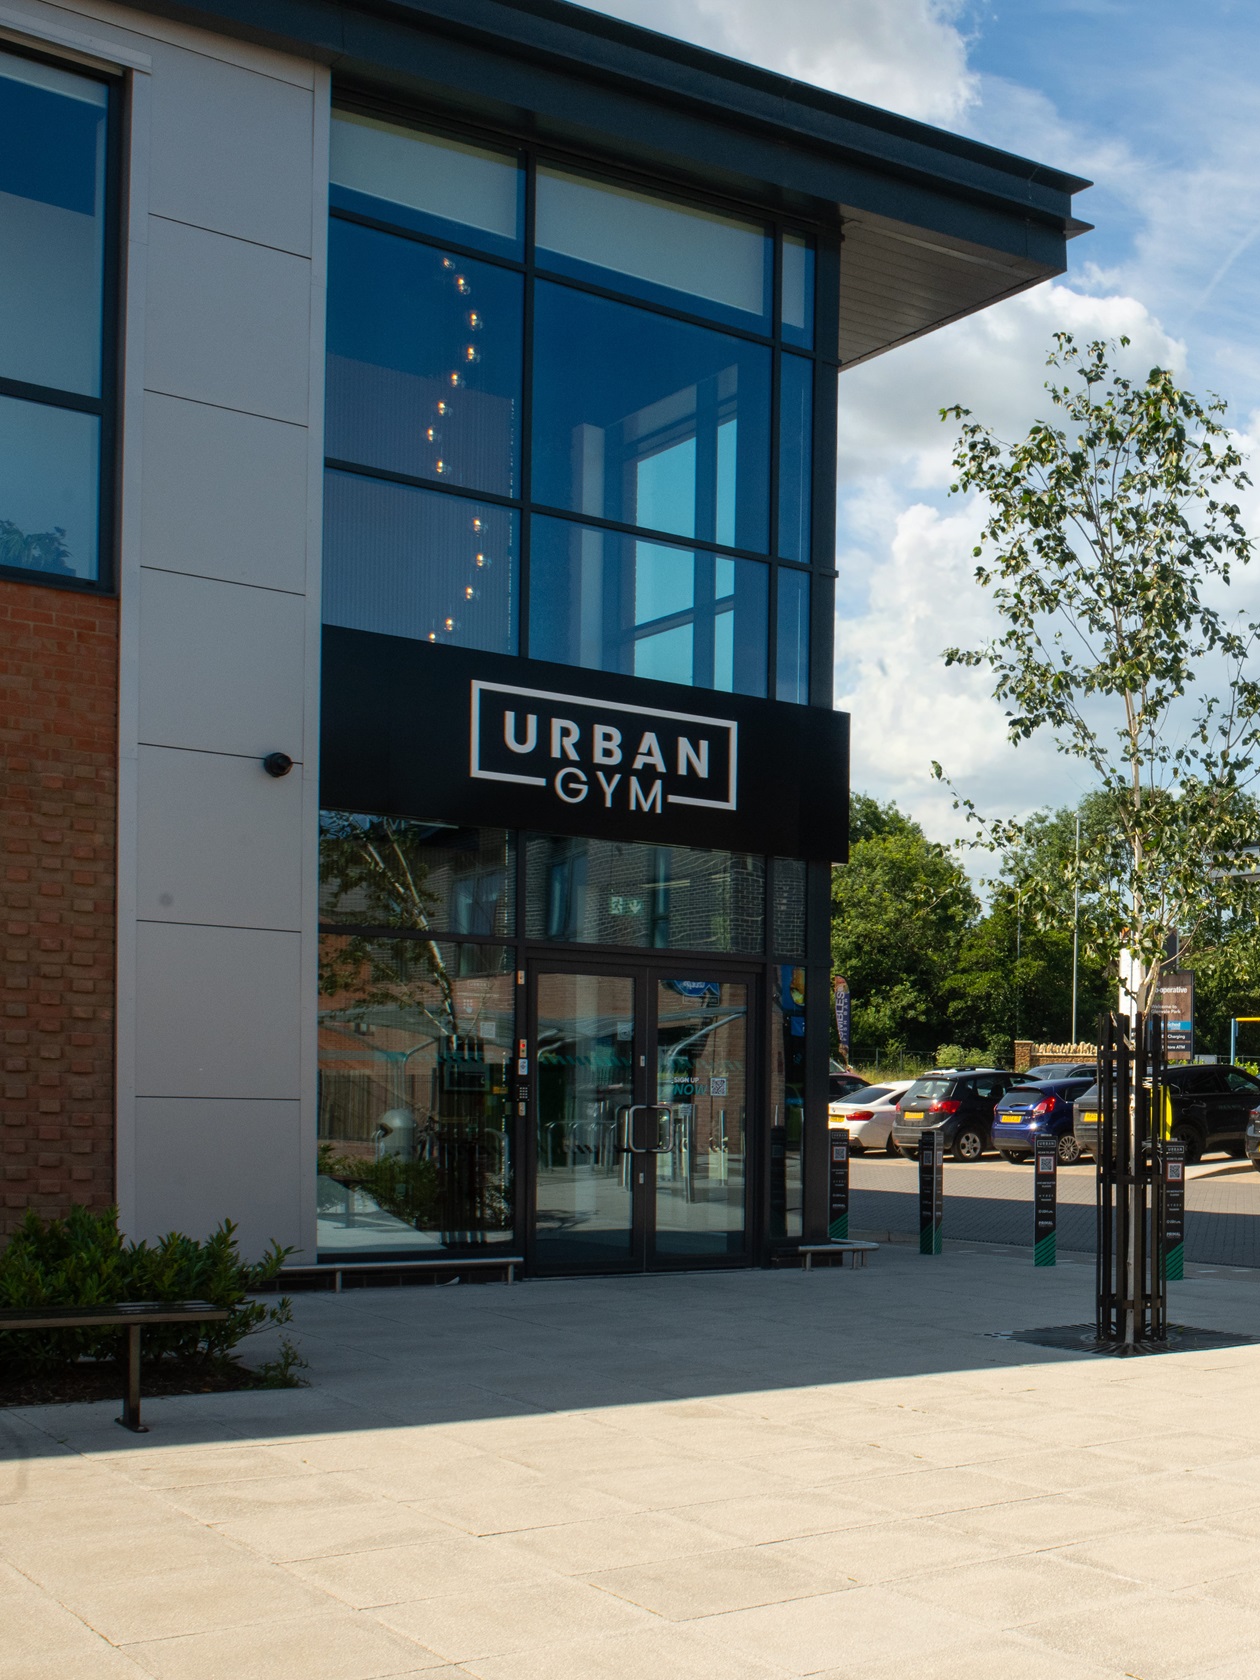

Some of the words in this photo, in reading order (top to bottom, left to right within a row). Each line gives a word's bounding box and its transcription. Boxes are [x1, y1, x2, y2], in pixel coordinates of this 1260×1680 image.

[503, 710, 710, 779] URBAN
[554, 766, 663, 813] GYM
[673, 1083, 707, 1095] NOW
